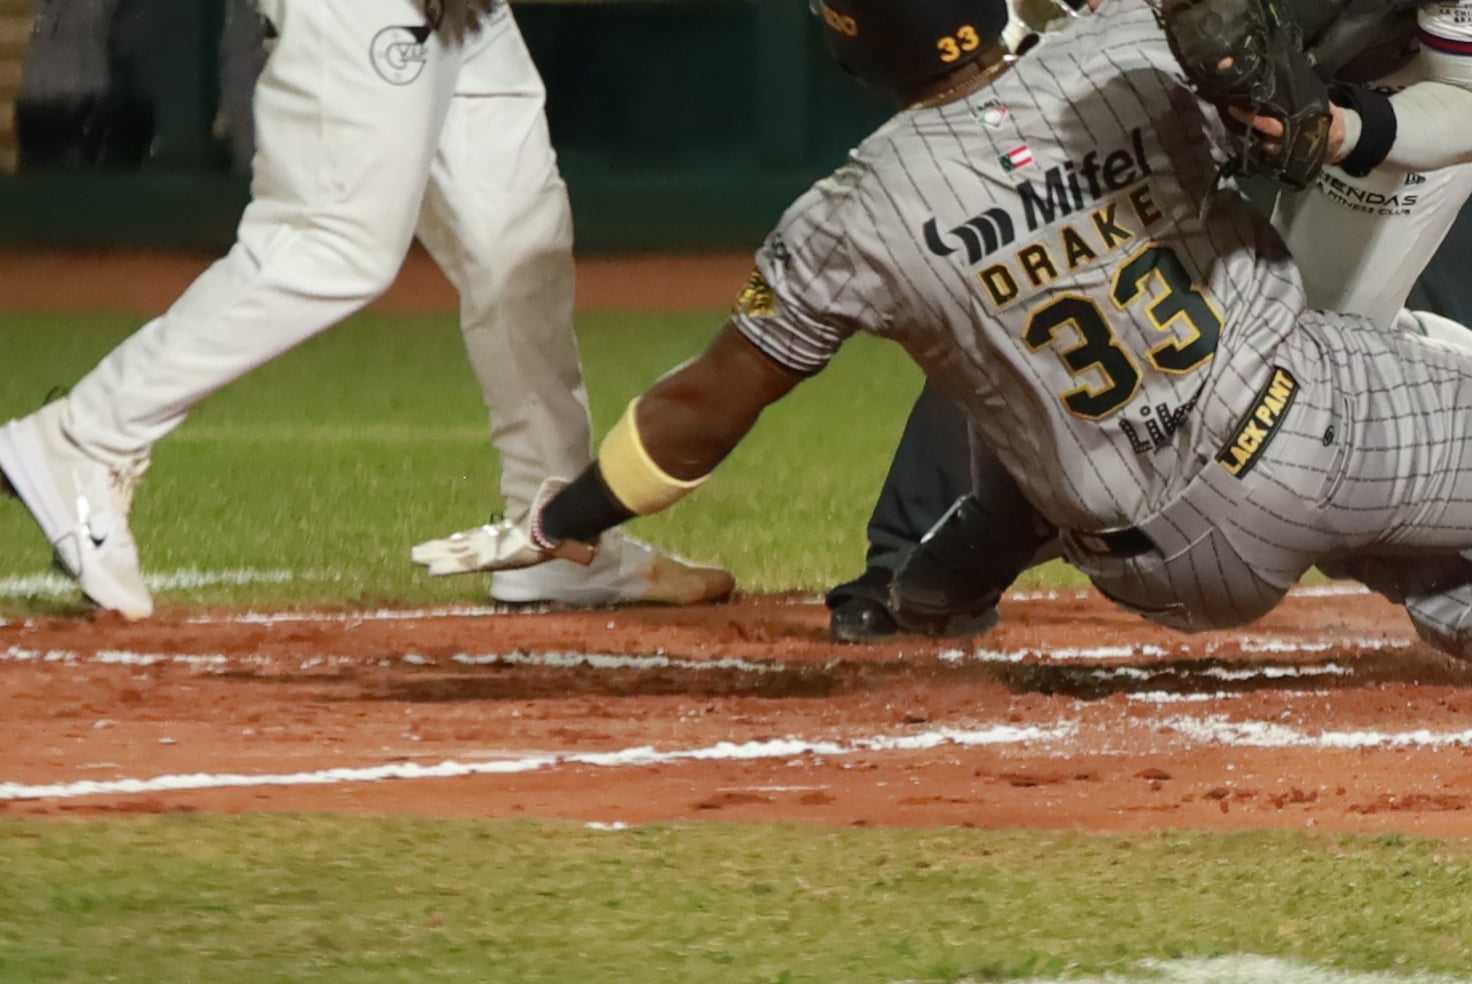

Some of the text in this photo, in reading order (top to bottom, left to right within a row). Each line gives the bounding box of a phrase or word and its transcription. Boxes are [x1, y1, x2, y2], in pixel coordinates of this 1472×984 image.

[936, 24, 980, 63] 33
[1016, 127, 1150, 232] Mifel
[1319, 167, 1418, 207] IENDAS
[977, 183, 1163, 308] DRAKE
[1021, 241, 1225, 421] 33
